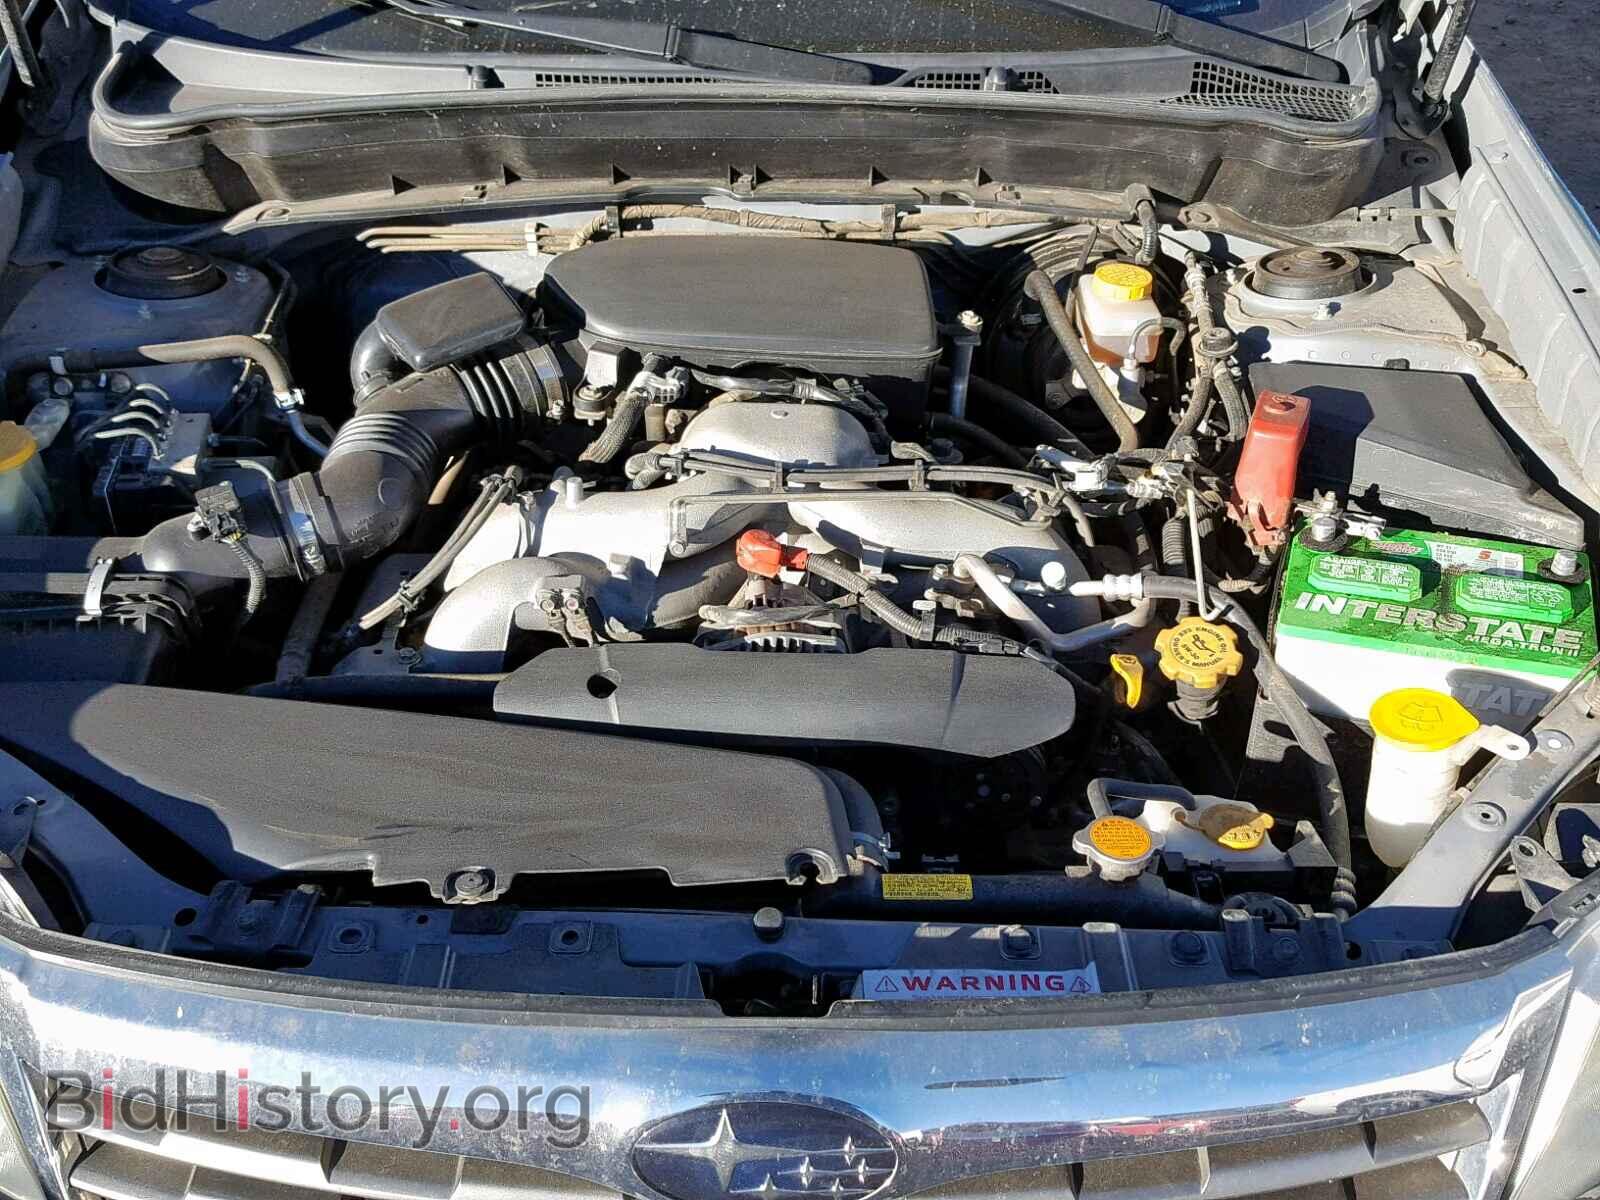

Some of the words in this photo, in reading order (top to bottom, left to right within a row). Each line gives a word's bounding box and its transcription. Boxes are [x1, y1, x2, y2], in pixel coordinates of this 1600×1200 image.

[1294, 592, 1585, 648] INTERSTATE
[1195, 627, 1225, 641] ENGINE
[902, 974, 1066, 992] WARNING
